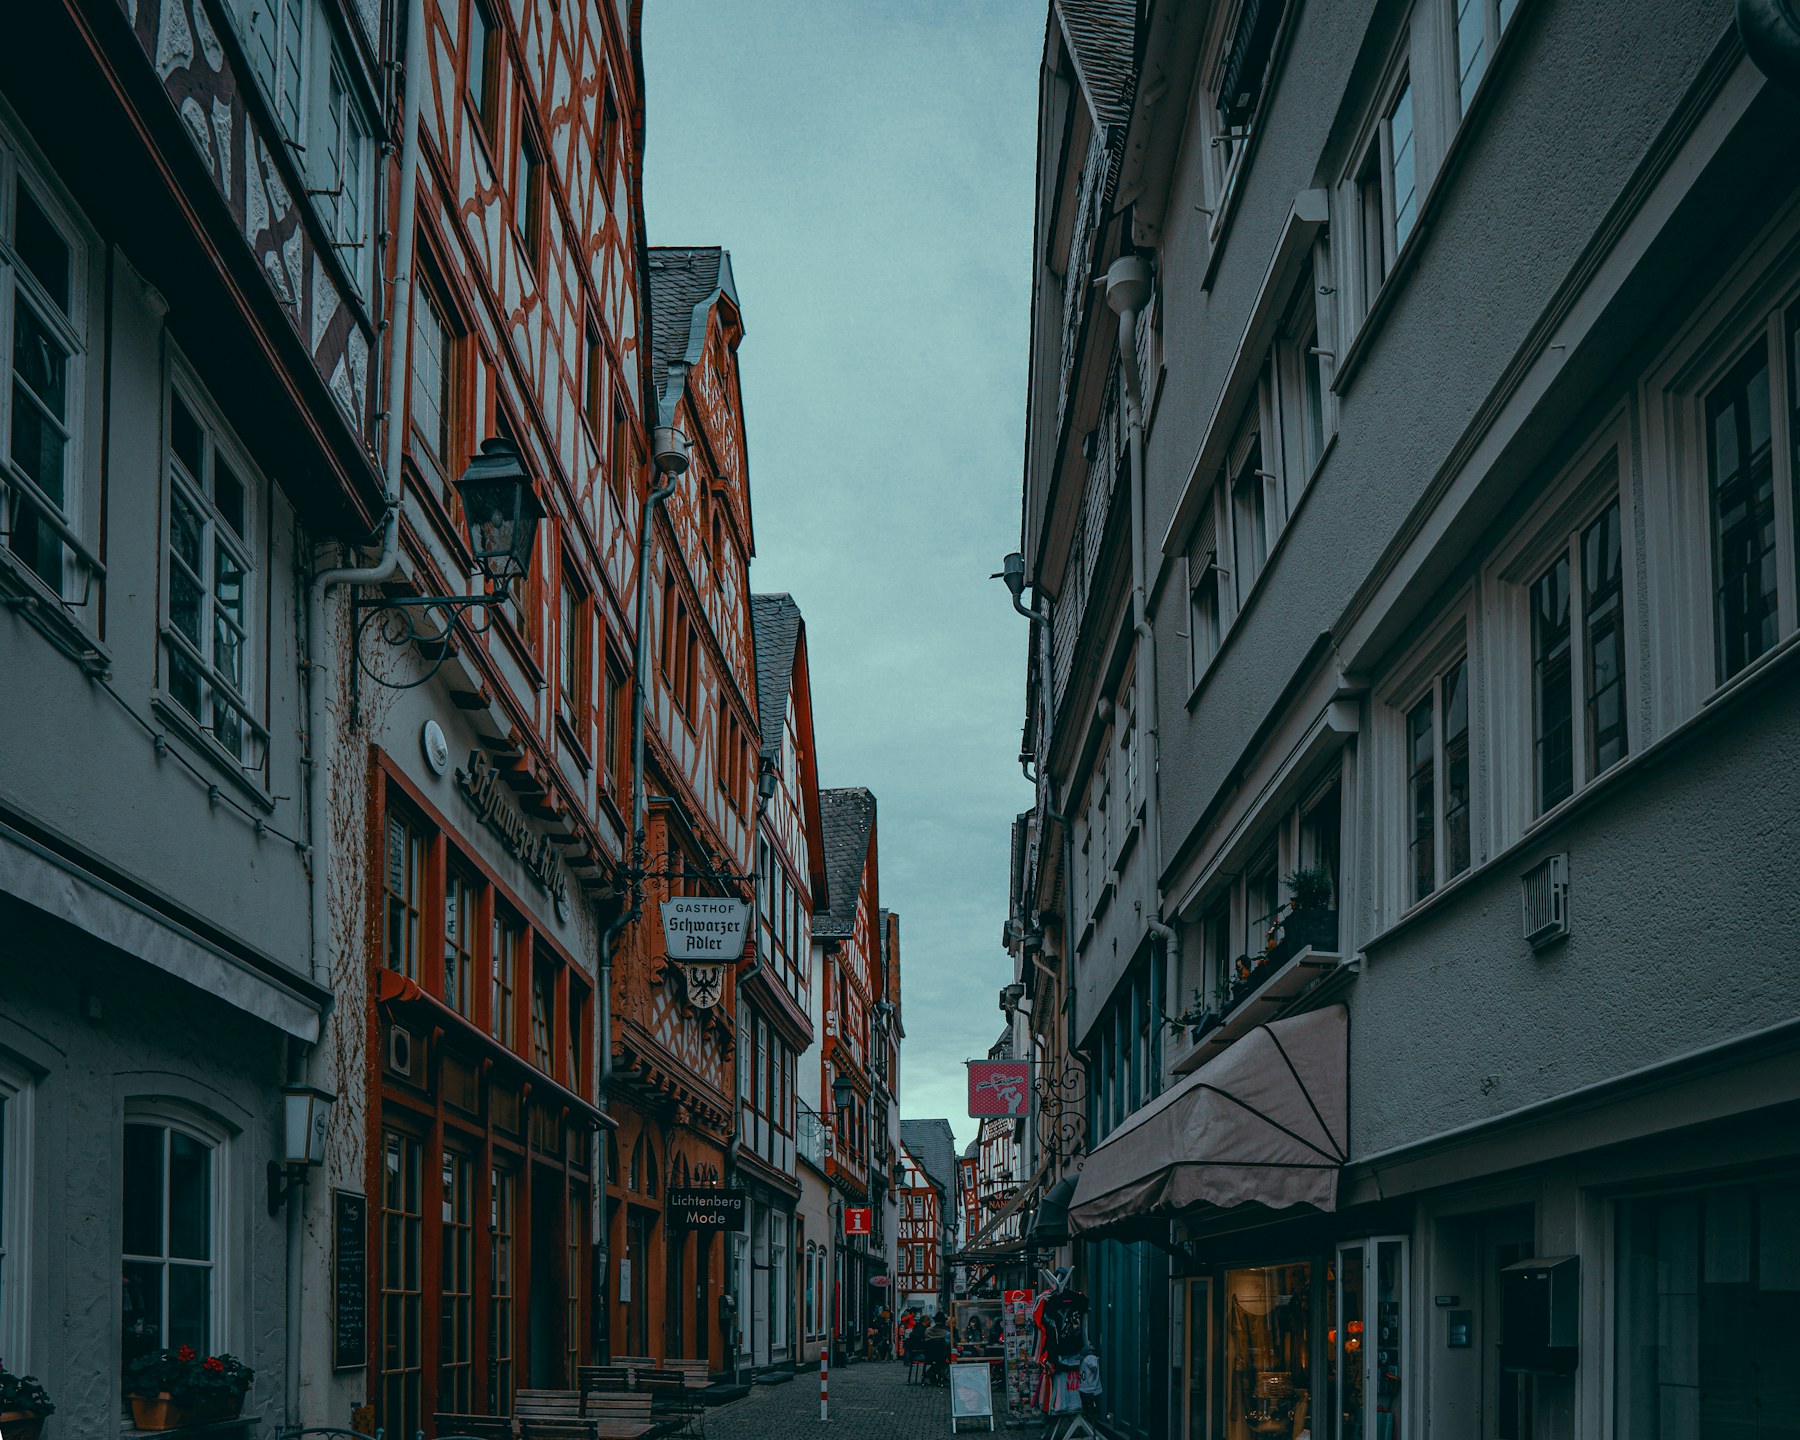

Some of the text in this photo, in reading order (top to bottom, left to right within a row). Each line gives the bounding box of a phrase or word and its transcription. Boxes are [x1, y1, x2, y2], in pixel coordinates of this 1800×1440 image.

[455, 749, 541, 864] Schwarzer
[676, 903, 735, 913] GASTHOF
[669, 917, 740, 935] Schwarzer
[686, 935, 722, 952] Adler
[671, 1194, 742, 1210] Lichtenberg
[686, 1211, 726, 1224] Mode
